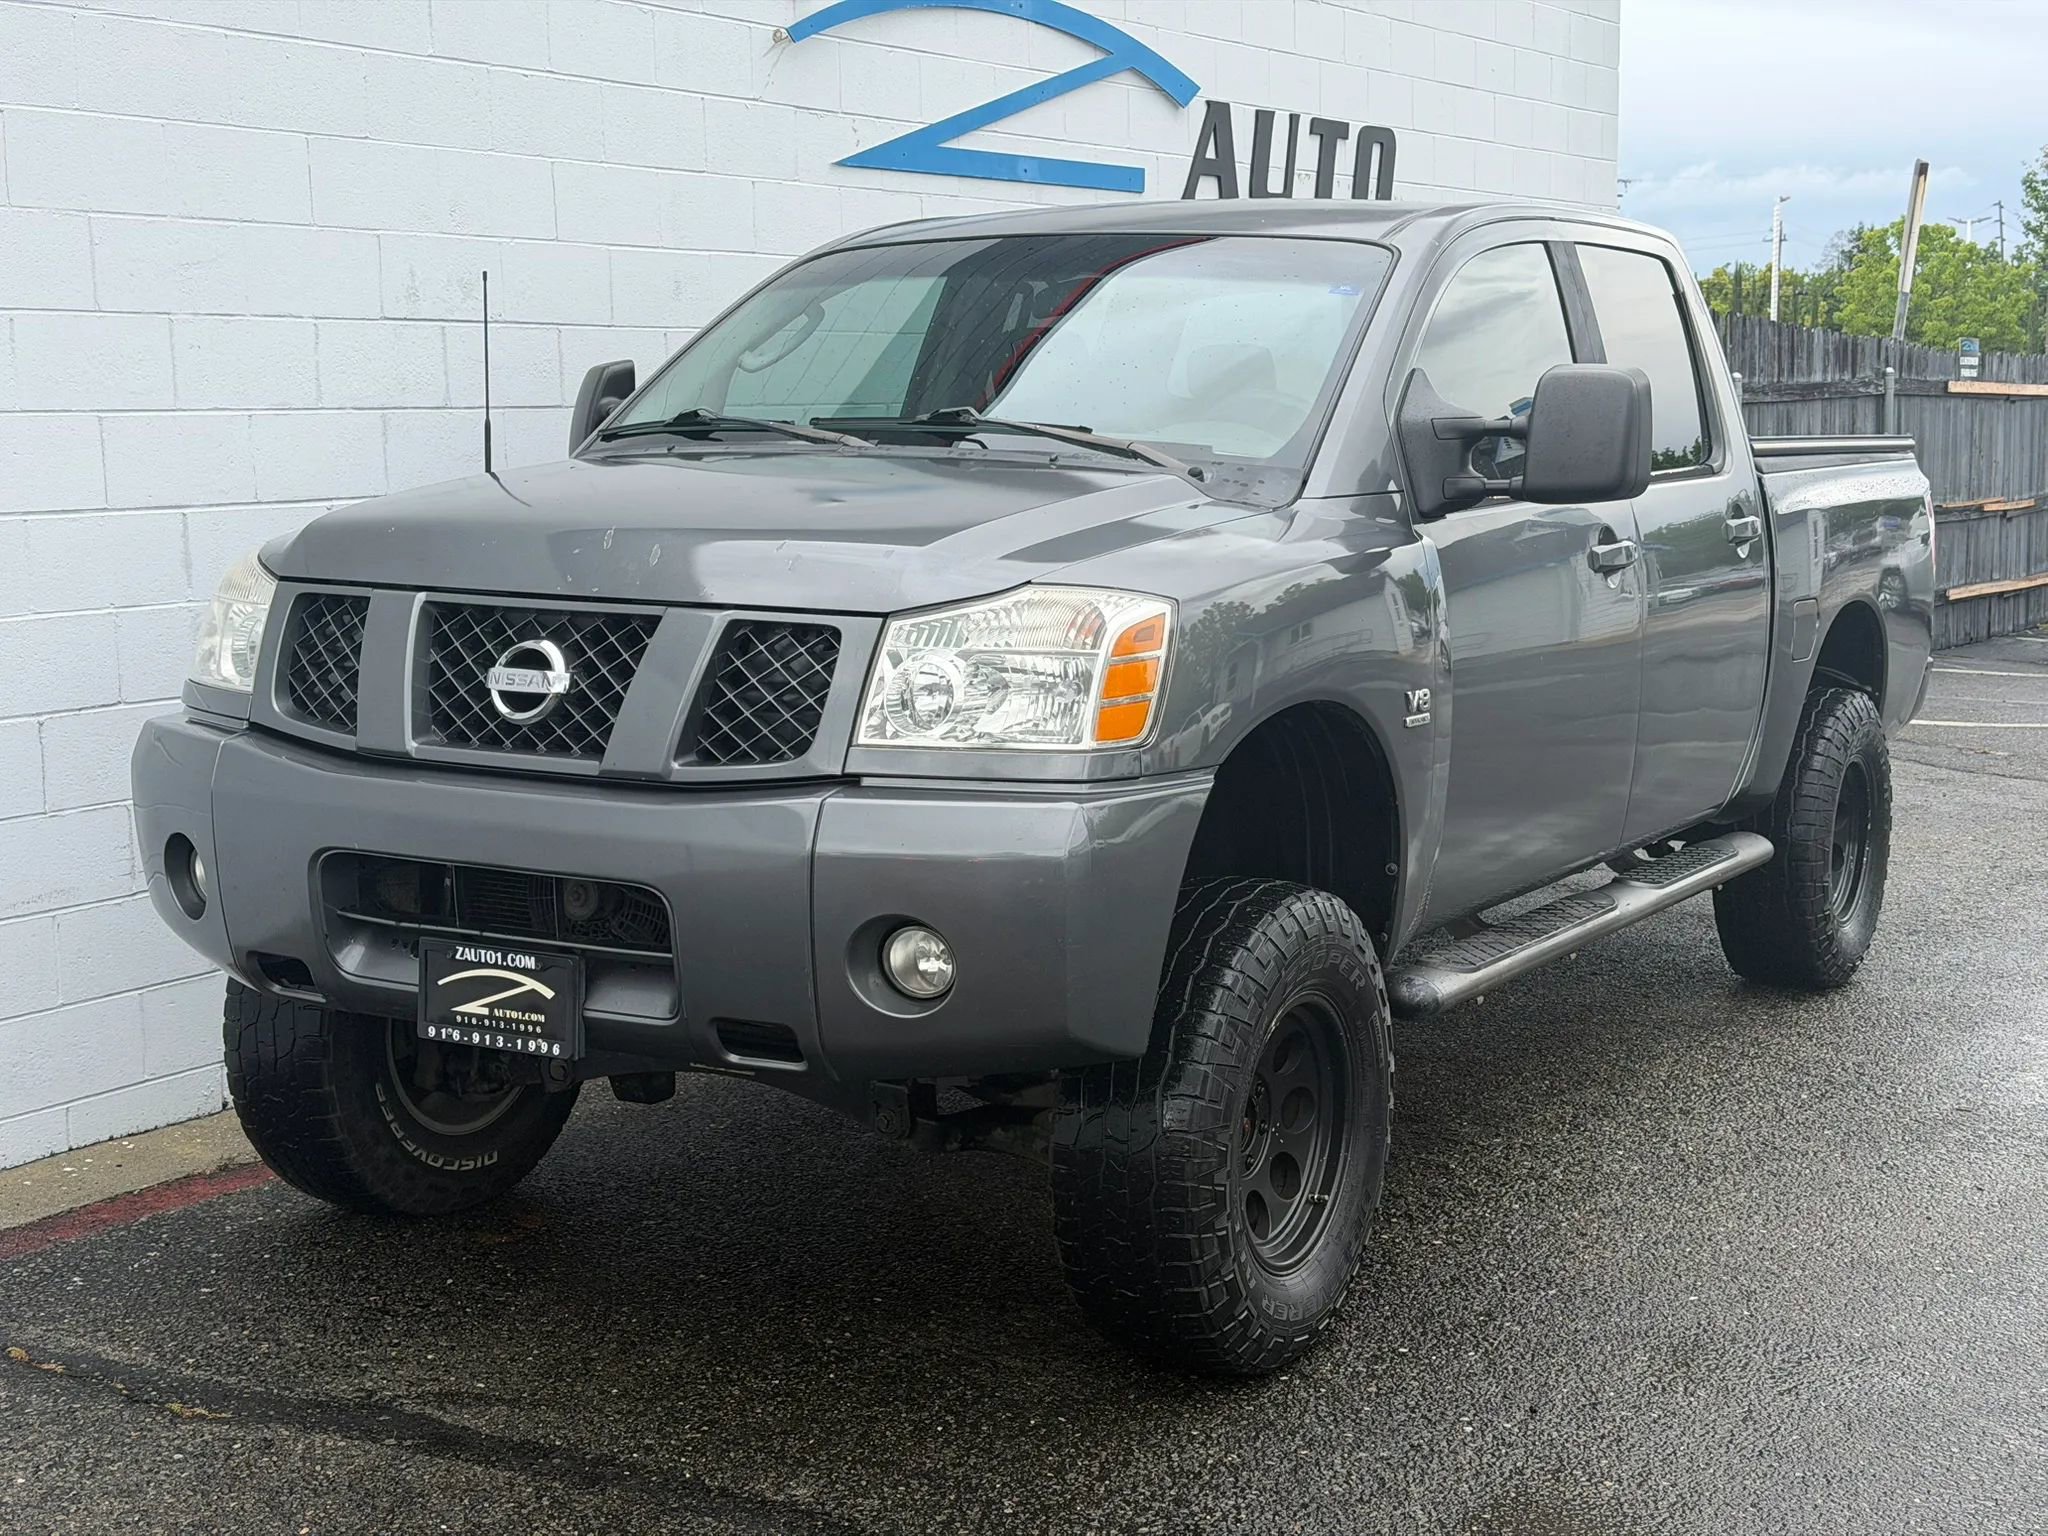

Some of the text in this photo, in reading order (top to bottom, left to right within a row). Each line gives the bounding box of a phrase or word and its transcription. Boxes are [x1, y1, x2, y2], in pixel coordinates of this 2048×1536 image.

[1181, 99, 1397, 200] AUTO
[489, 671, 554, 692] NISSAN
[1404, 688, 1431, 712] V8
[455, 946, 536, 970] ZAUTO1.COM
[1284, 947, 1366, 996] COOPER
[492, 1008, 545, 1023] AUTO1.COM
[375, 1083, 498, 1171] DISCOVERER
